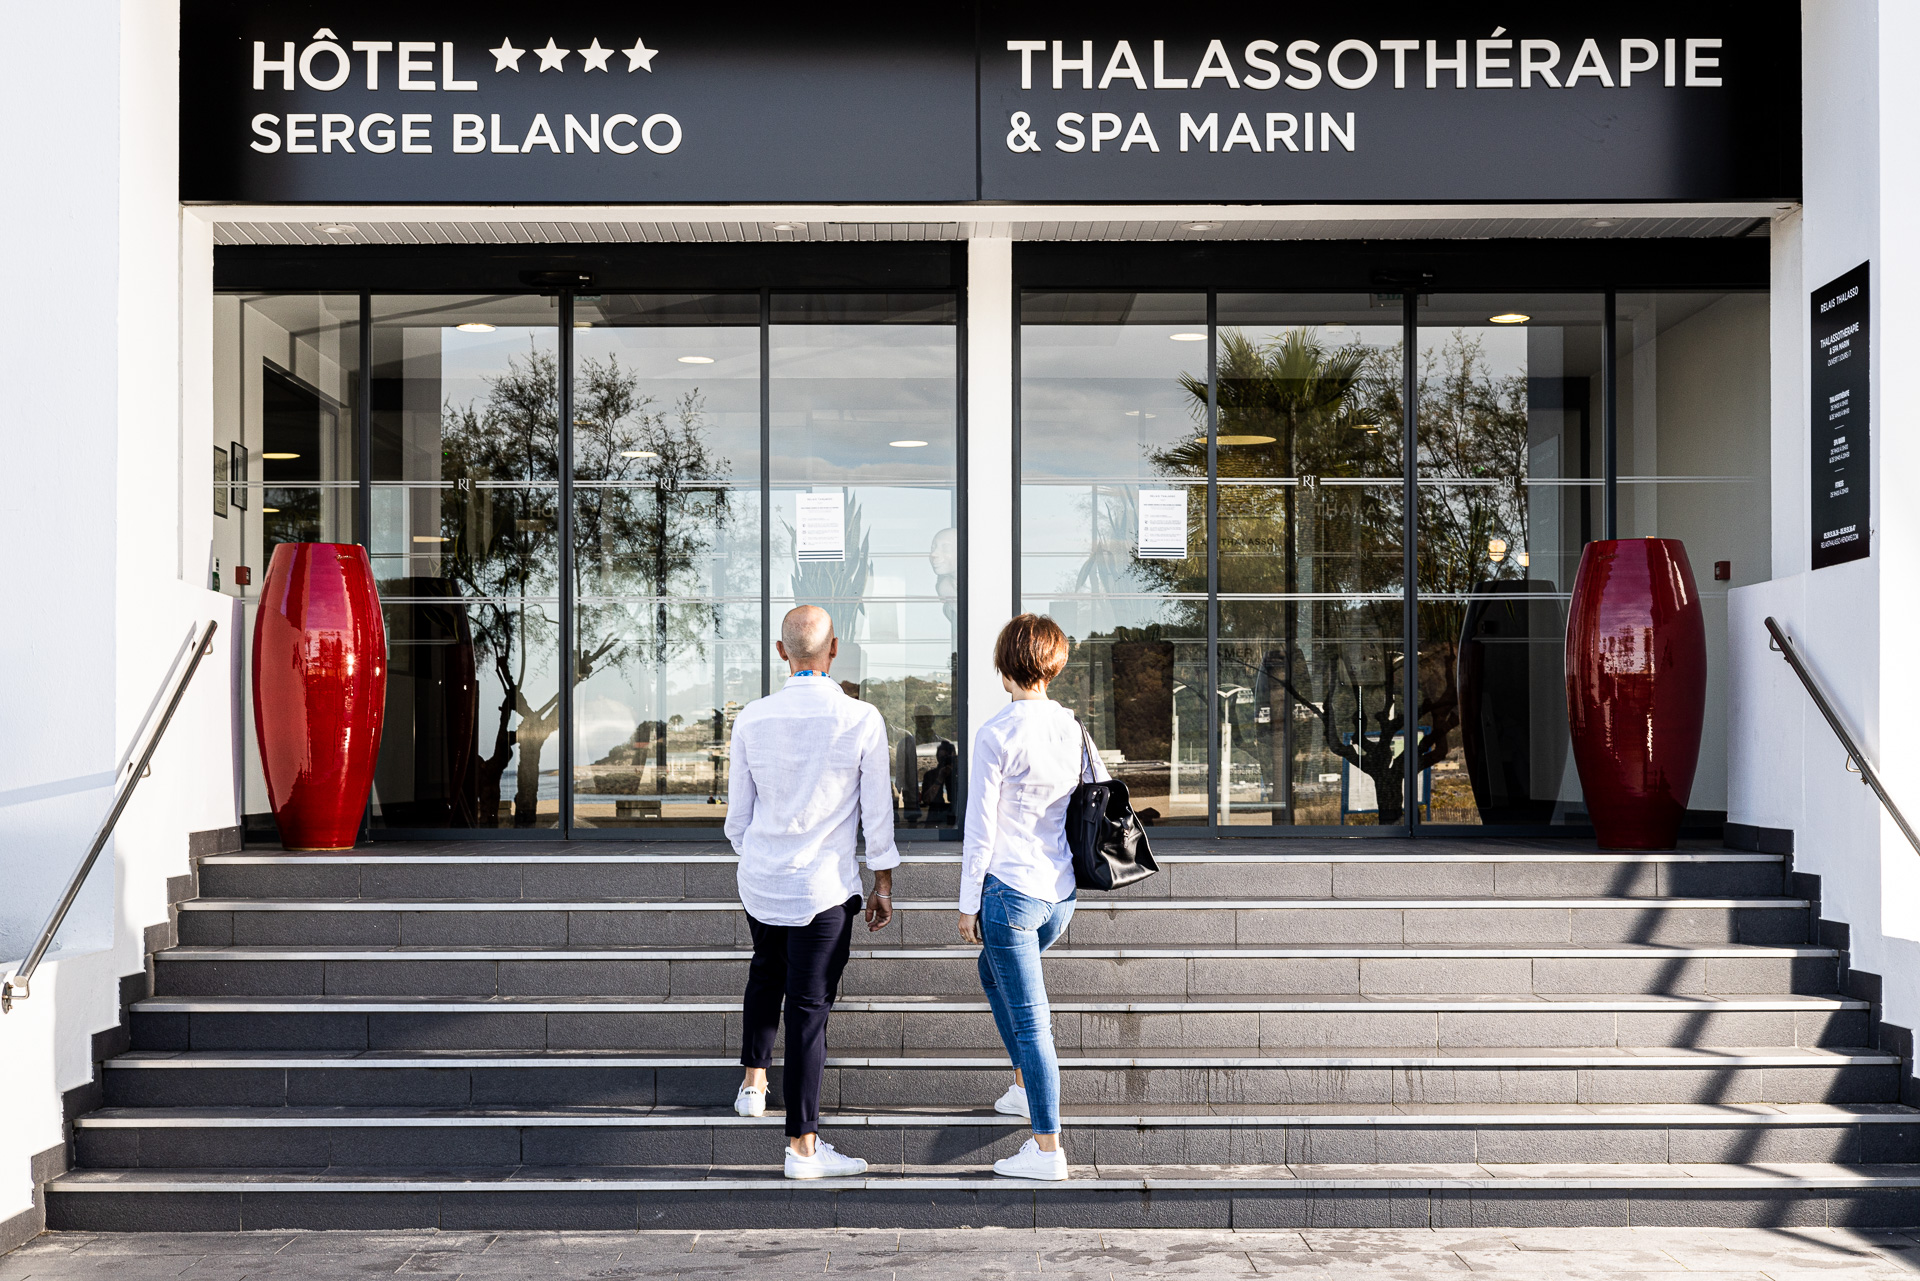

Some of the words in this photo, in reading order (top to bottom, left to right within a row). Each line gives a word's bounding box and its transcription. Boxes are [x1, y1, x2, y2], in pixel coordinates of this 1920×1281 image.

[252, 28, 478, 91] HÔTEL
[1006, 27, 1723, 90] THALASSOTHÉRAPIE
[250, 113, 433, 154] SERGE
[452, 113, 683, 155] BLANCO
[1006, 111, 1042, 153] &
[1054, 112, 1161, 153] SPA
[1179, 112, 1356, 153] MARIN
[1820, 298, 1836, 314] RELAIS
[1835, 286, 1859, 306] THALASSO
